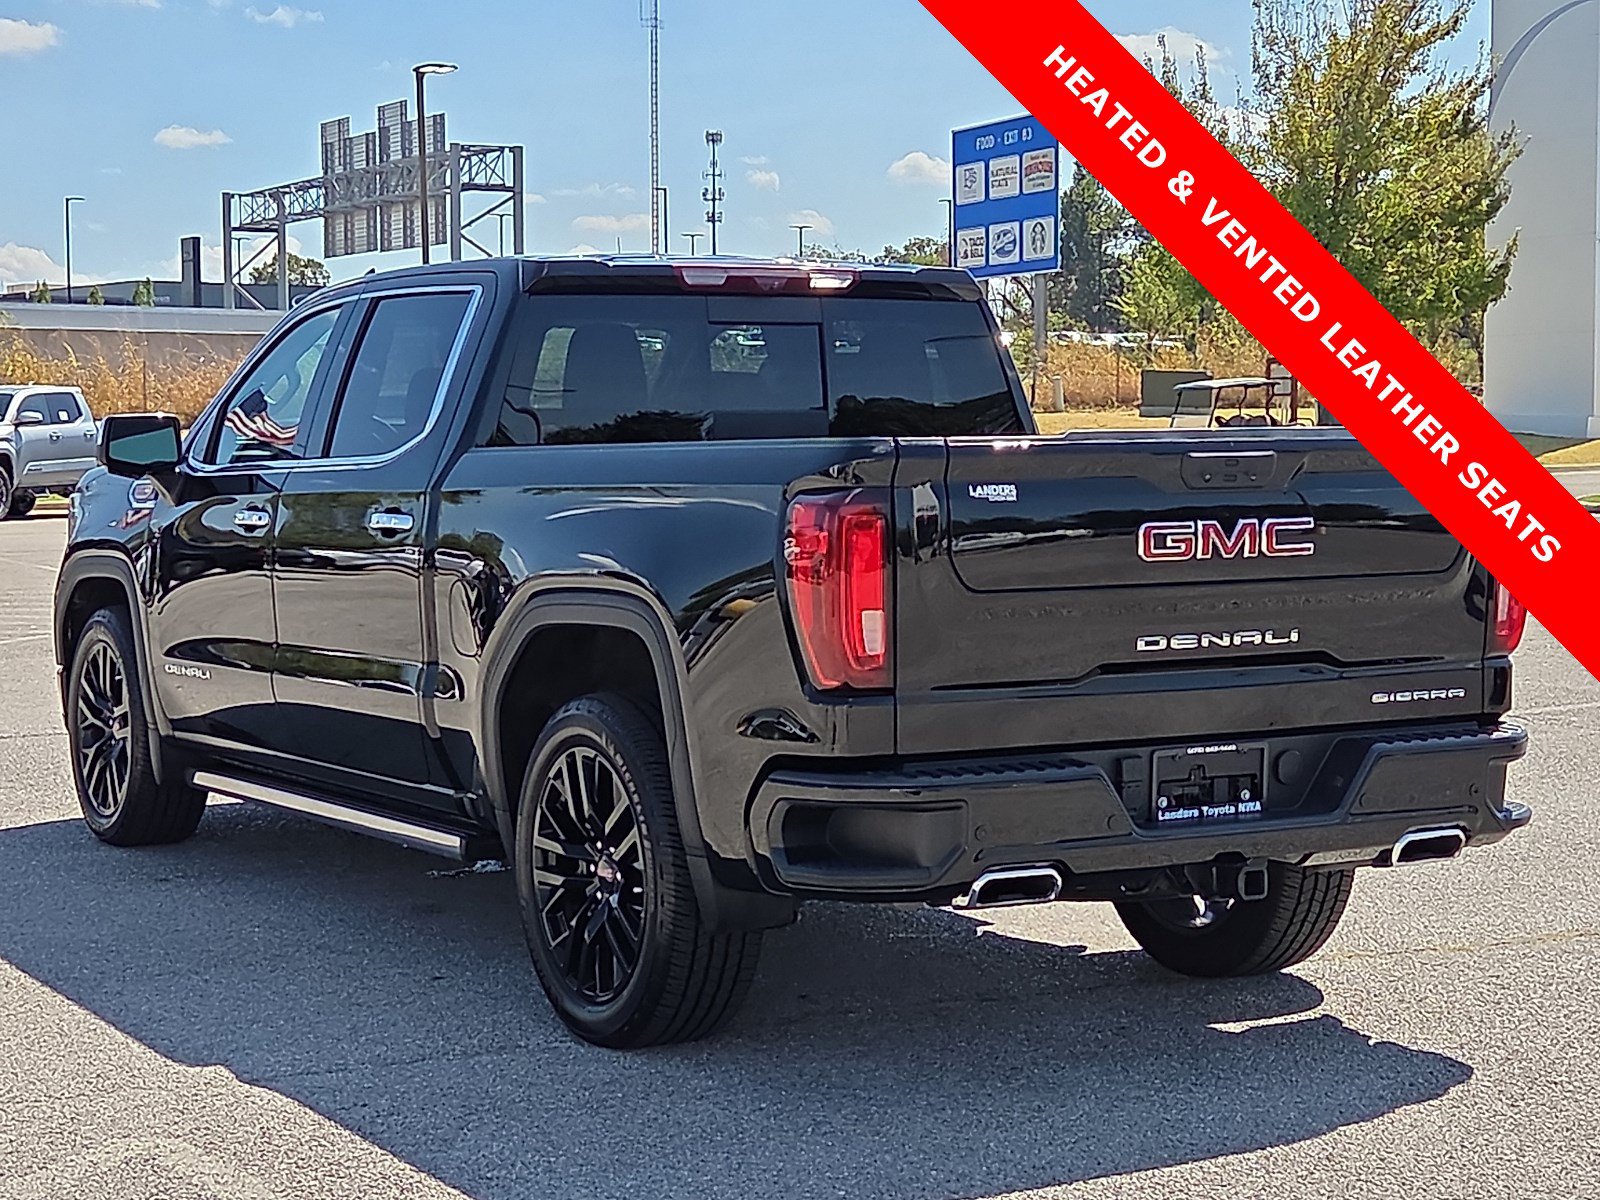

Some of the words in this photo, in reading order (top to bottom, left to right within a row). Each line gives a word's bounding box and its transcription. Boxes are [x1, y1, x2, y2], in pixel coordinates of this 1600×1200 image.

[975, 134, 995, 151] FOOD
[1003, 129, 1019, 145] EXIT
[969, 236, 985, 247] TACO
[969, 484, 1016, 497] LANDERS
[1137, 517, 1314, 562] GMC
[1136, 629, 1299, 651] DENALI
[164, 664, 211, 680] DENALI
[1371, 688, 1465, 704] SIERRA
[1158, 808, 1199, 821] Landers
[1201, 804, 1236, 817] Toyota
[1237, 801, 1262, 813] NWA
